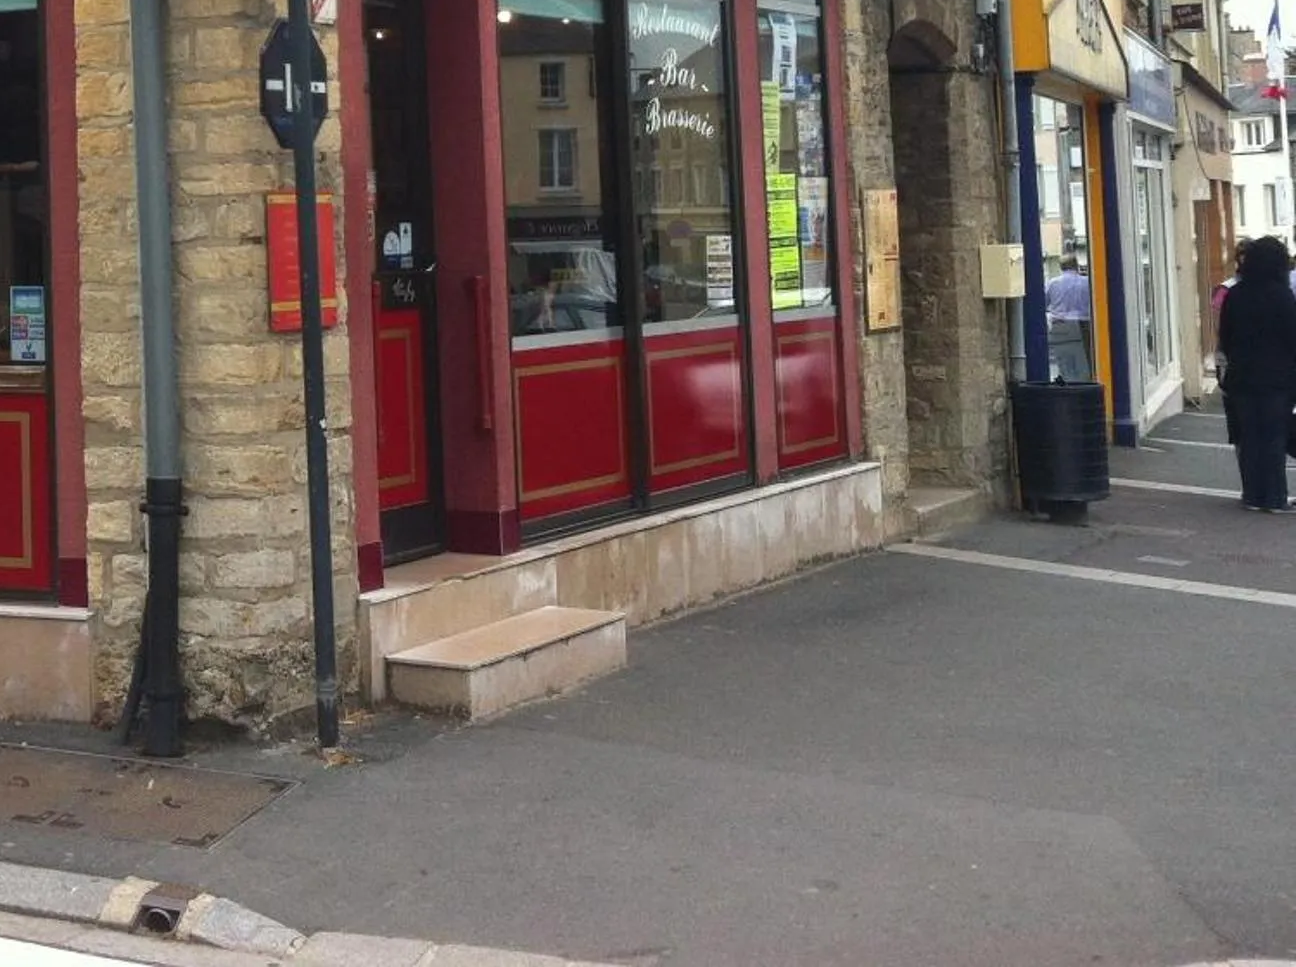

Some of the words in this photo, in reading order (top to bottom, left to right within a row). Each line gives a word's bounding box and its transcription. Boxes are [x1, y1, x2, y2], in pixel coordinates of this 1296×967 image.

[633, 2, 720, 47] Restaurant
[660, 48, 697, 91] Bar
[645, 97, 715, 139] Brasserie
